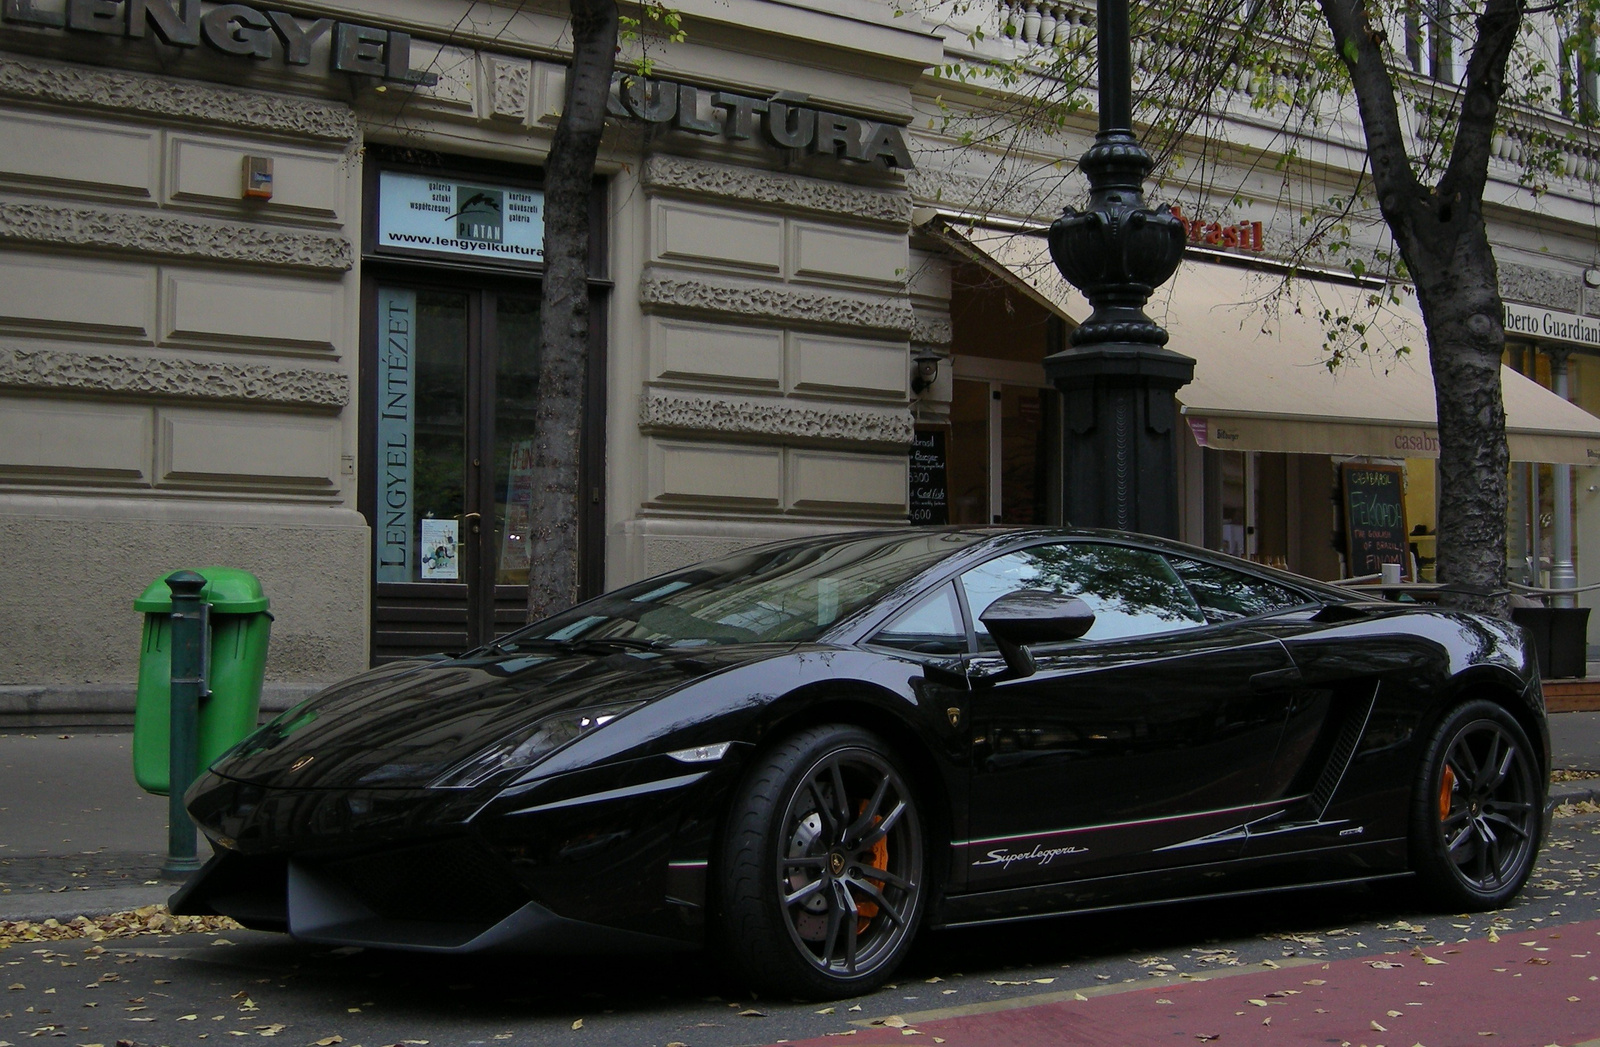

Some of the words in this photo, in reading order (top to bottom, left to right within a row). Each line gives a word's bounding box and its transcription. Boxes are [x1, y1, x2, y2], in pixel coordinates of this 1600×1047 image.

[2, 0, 438, 87] LENGYEL
[429, 182, 451, 192] galeria
[432, 193, 451, 203] sztuki
[459, 223, 501, 241] PLATAN
[381, 300, 409, 421] INTÉZET
[380, 433, 407, 569] LENGYEL
[972, 844, 1089, 869] Superleggera
